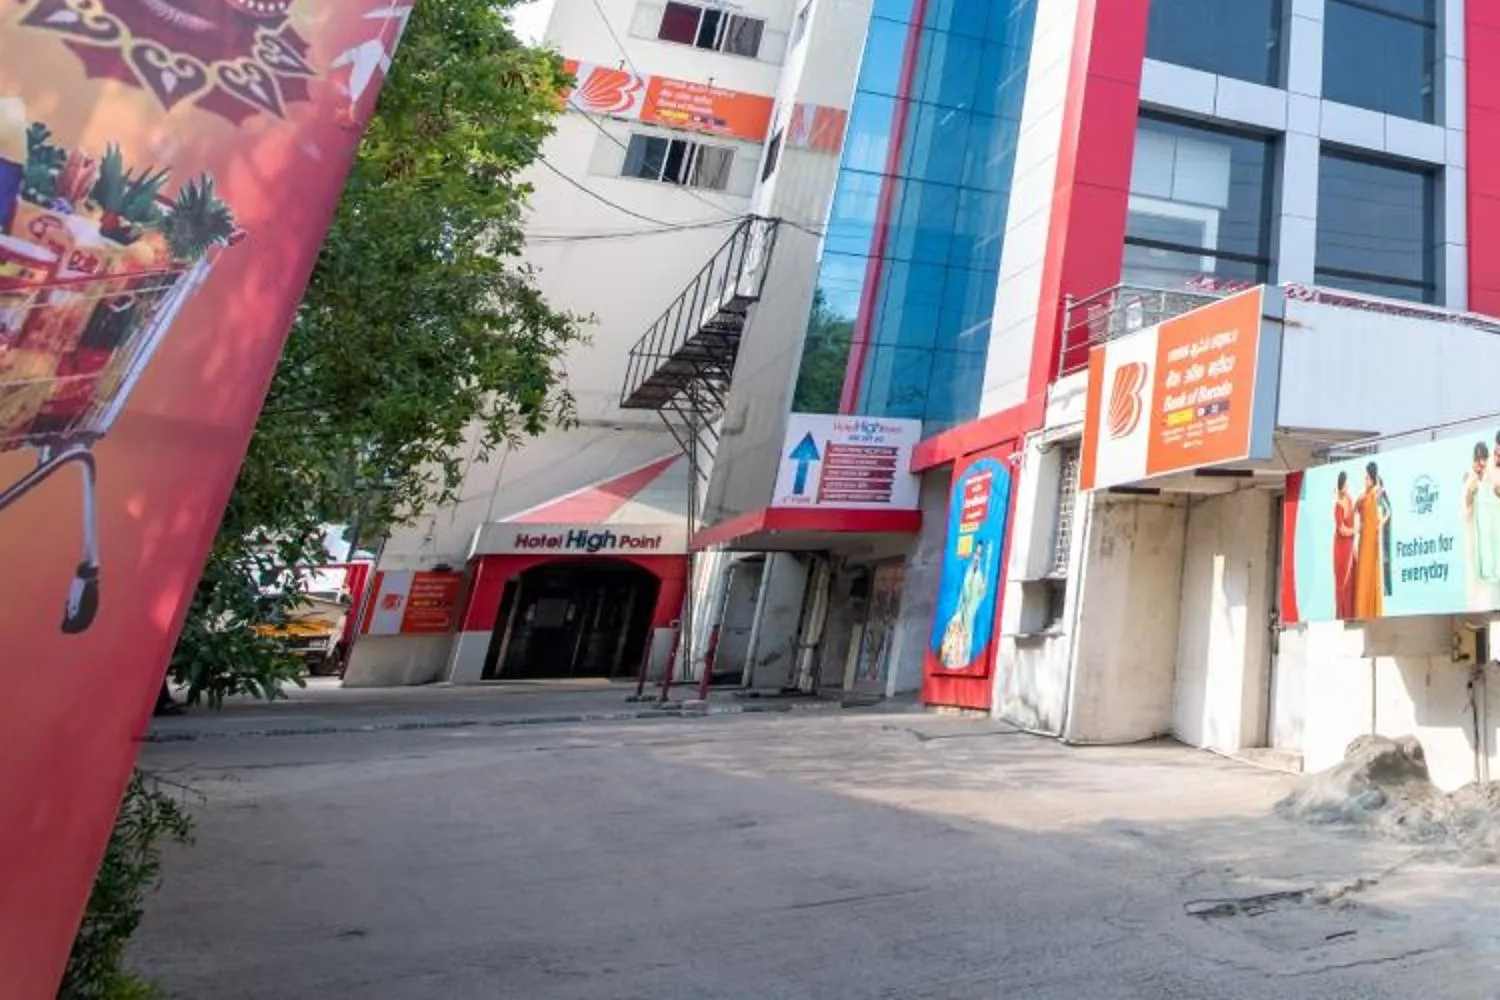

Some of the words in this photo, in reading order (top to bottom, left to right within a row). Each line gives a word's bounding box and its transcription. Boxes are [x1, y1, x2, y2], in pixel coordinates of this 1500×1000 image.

[515, 534, 562, 549] Hotel
[565, 530, 617, 552] High
[619, 535, 662, 549] Point
[1396, 537, 1437, 558] Fashion
[1438, 533, 1454, 553] for
[1402, 562, 1449, 583] everyday
